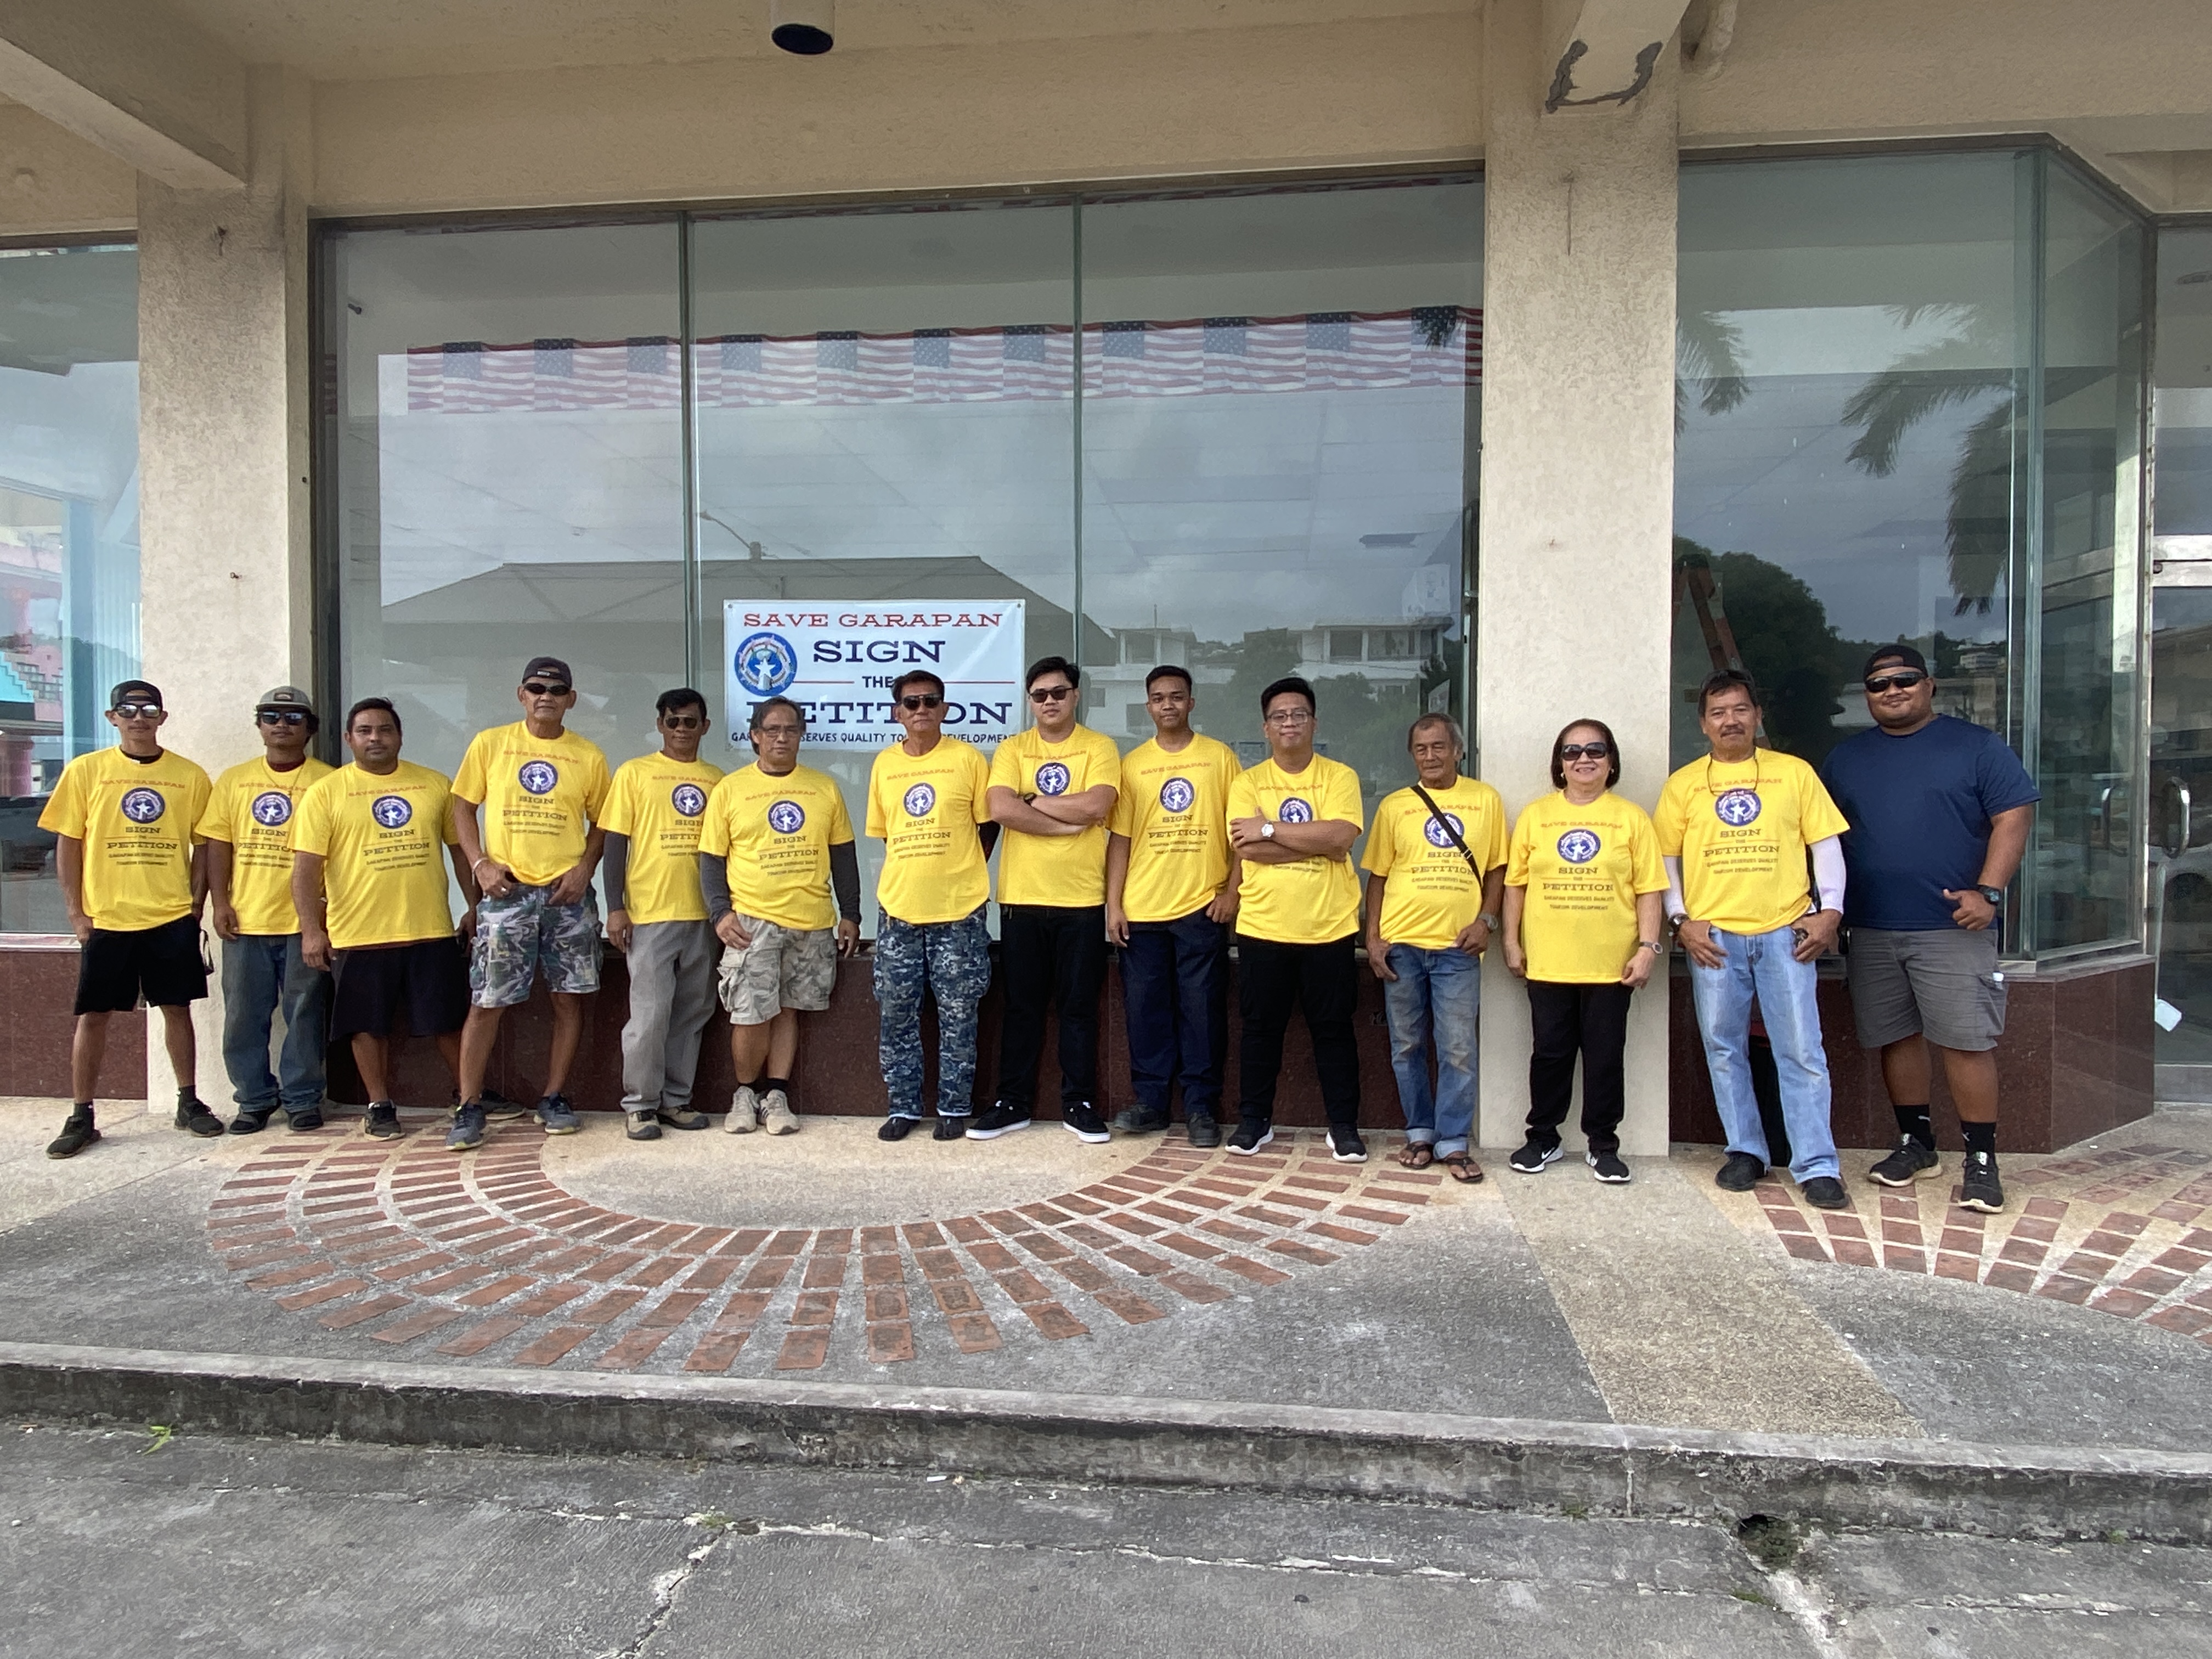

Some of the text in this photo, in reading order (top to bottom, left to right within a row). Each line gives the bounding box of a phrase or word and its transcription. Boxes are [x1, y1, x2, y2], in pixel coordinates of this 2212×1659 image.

[743, 613, 1003, 627] SAVE GARAPAN
[813, 640, 945, 663] SIGN
[862, 676, 894, 688] THE
[840, 732, 886, 744] QUALITY
[503, 810, 567, 820] PETITION
[906, 818, 935, 827] SIGN
[380, 830, 415, 838] SIGN
[893, 832, 951, 844] PETITION
[1148, 830, 1208, 838] PETITION
[1720, 829, 1760, 838] SIGN
[238, 843, 291, 852] PETITIO
[363, 843, 430, 856] PETITION
[1703, 845, 1780, 857] PETITION
[759, 849, 819, 860] PETITION
